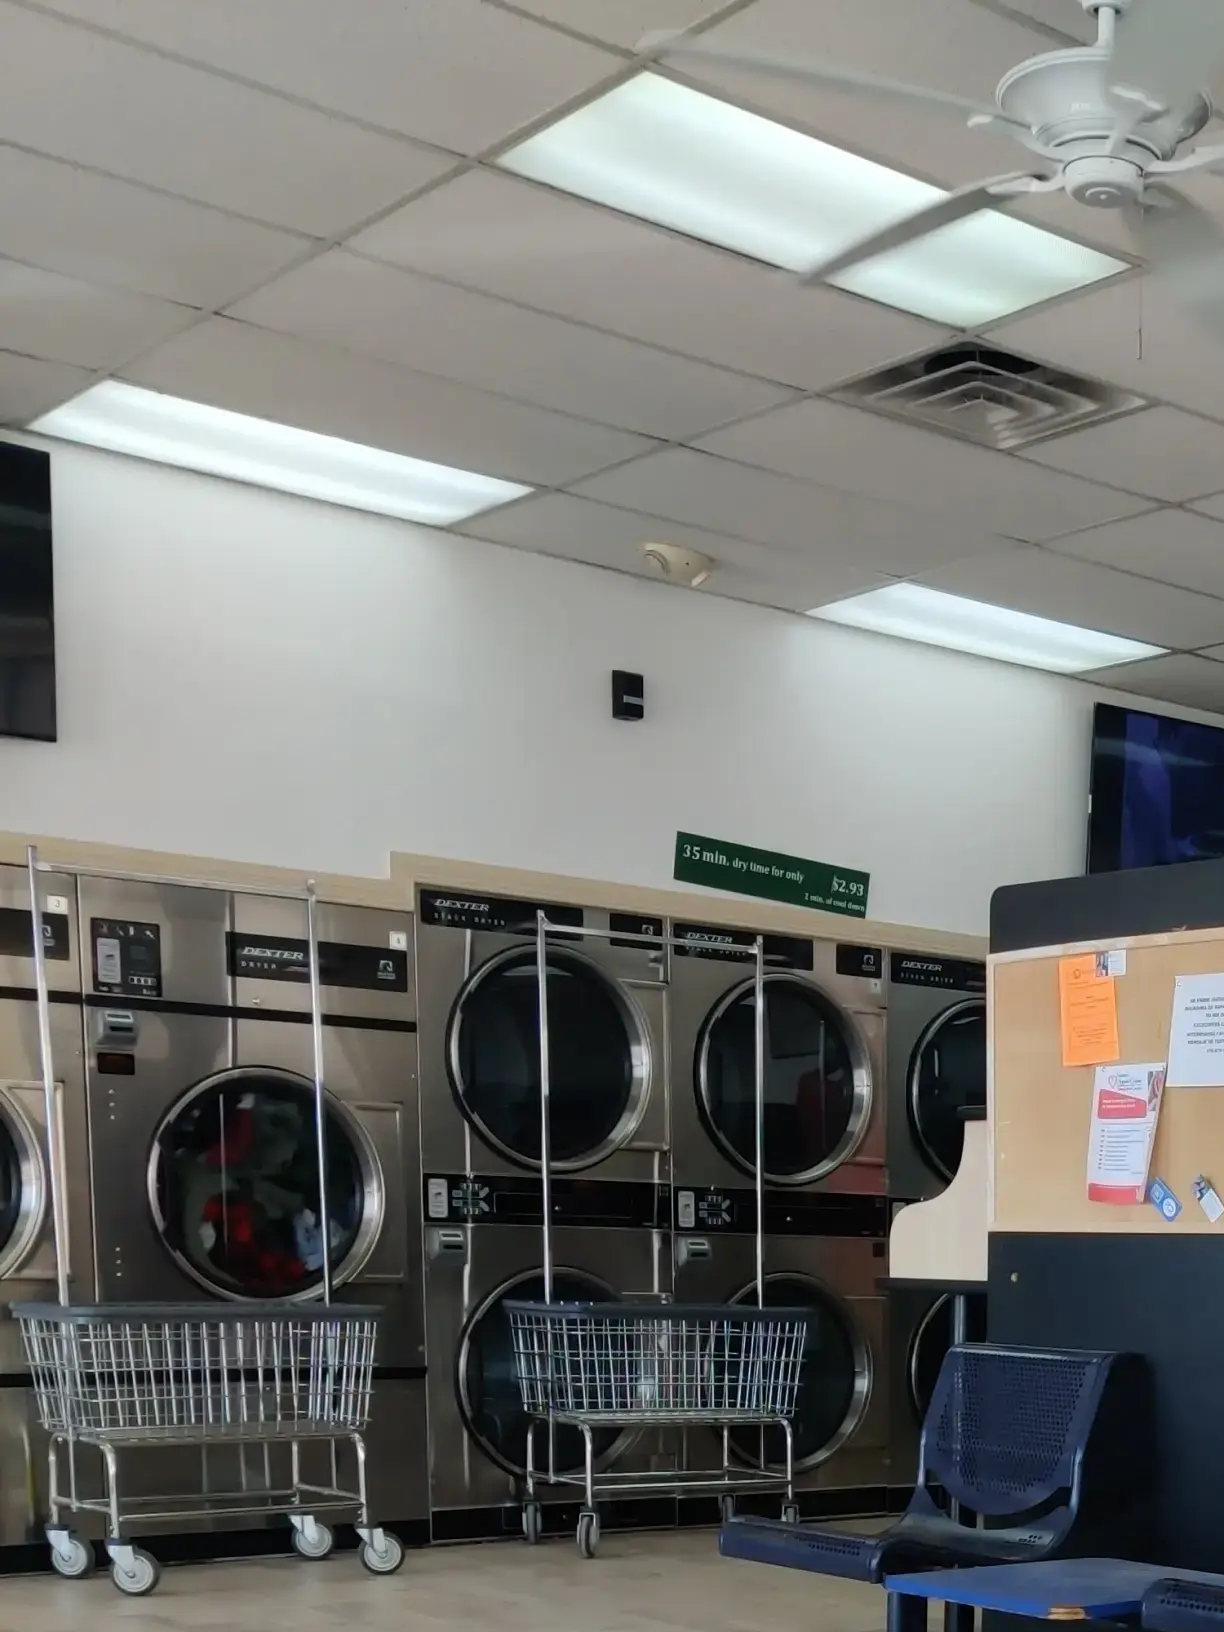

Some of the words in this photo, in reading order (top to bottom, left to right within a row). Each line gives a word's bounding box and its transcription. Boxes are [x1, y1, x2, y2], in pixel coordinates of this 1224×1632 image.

[682, 844, 701, 860] 35
[702, 850, 730, 866] min.
[732, 857, 749, 872] dry
[750, 861, 770, 875] time
[771, 865, 785, 878] for
[786, 871, 805, 884] only
[831, 875, 864, 897] $2.93
[434, 898, 490, 912] DEXTER
[686, 931, 733, 944] DEXTER
[241, 946, 304, 961] DEXTER
[901, 960, 943, 972] DEXTER
